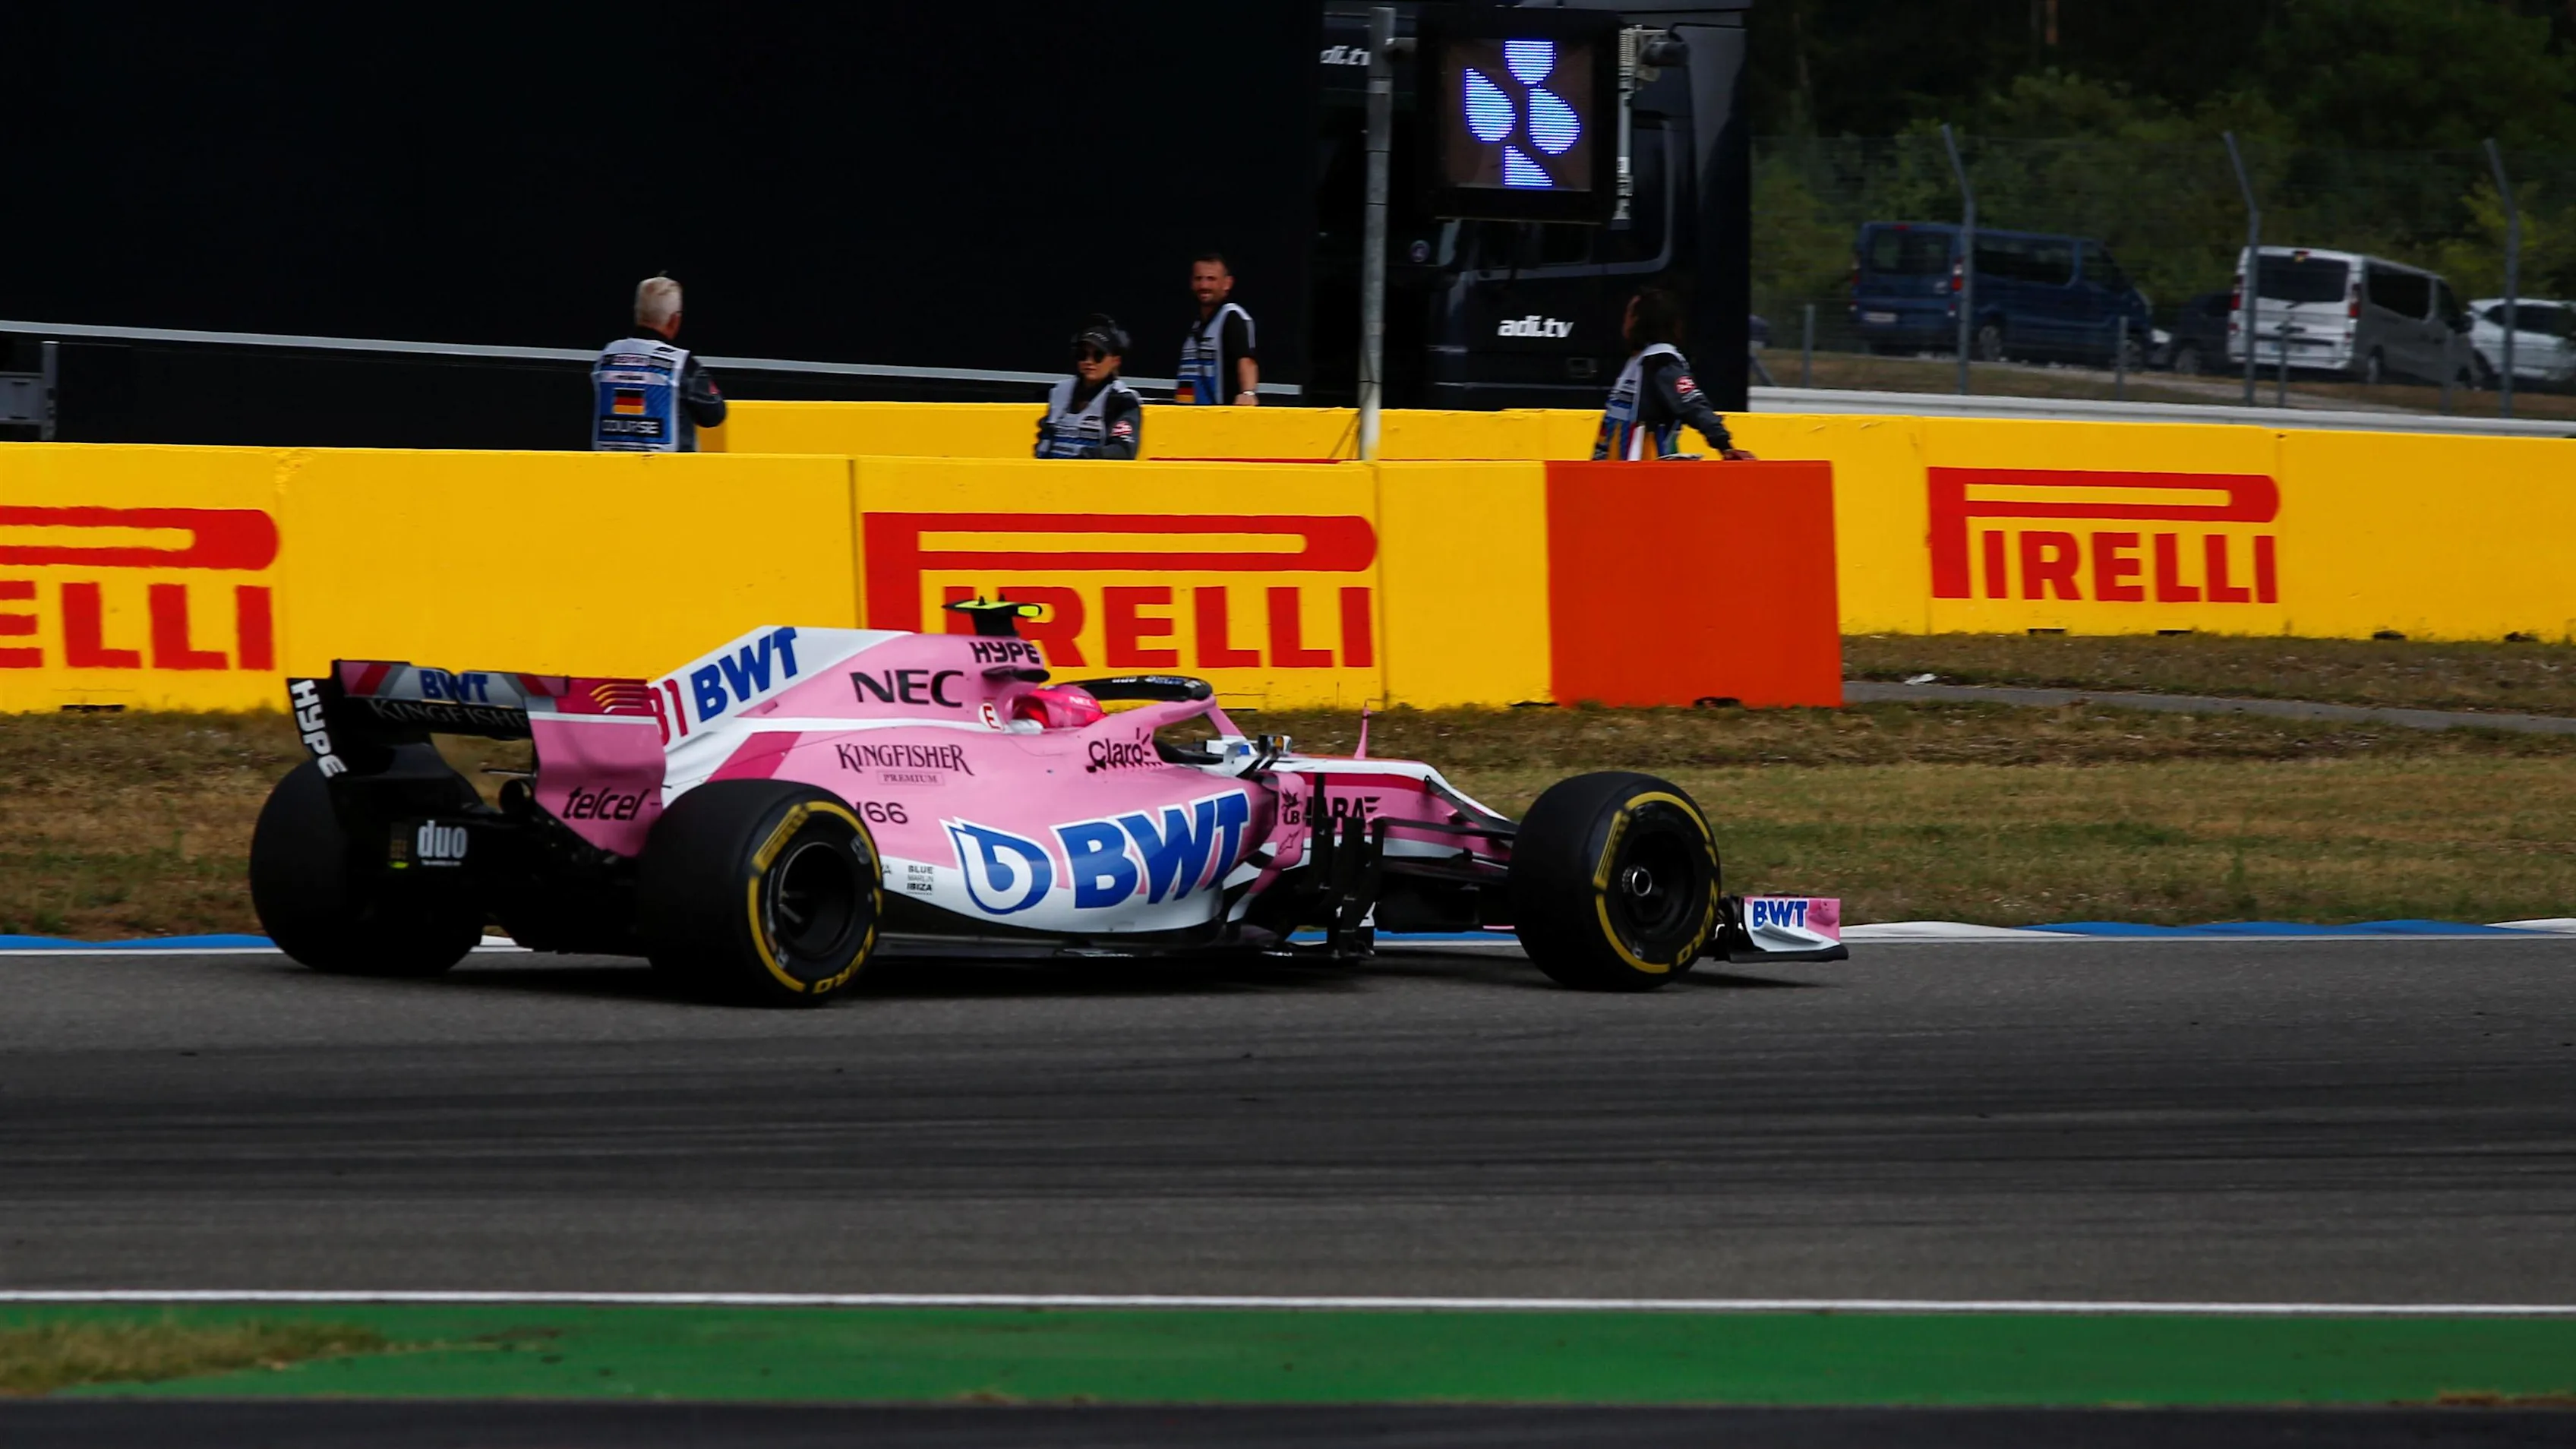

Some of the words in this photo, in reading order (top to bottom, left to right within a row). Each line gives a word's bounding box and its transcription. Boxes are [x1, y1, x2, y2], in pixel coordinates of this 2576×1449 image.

[1497, 314, 1574, 338] adi.tv
[1927, 467, 2280, 604] PIRELLI
[969, 642, 1040, 665] HYPE
[419, 669, 489, 703] BWT
[690, 627, 797, 723] BWT
[849, 670, 964, 709] NEC
[290, 679, 349, 778] HYPE
[982, 706, 1001, 730] E
[835, 743, 976, 776] KINGFISHER
[883, 773, 938, 784] PREMIUM
[563, 787, 649, 821] telcel
[416, 819, 469, 859] duo
[1055, 791, 1249, 909] BWT
[908, 865, 933, 874] BLUE
[907, 882, 932, 891] IBIZA
[1753, 901, 1808, 927] BWT
